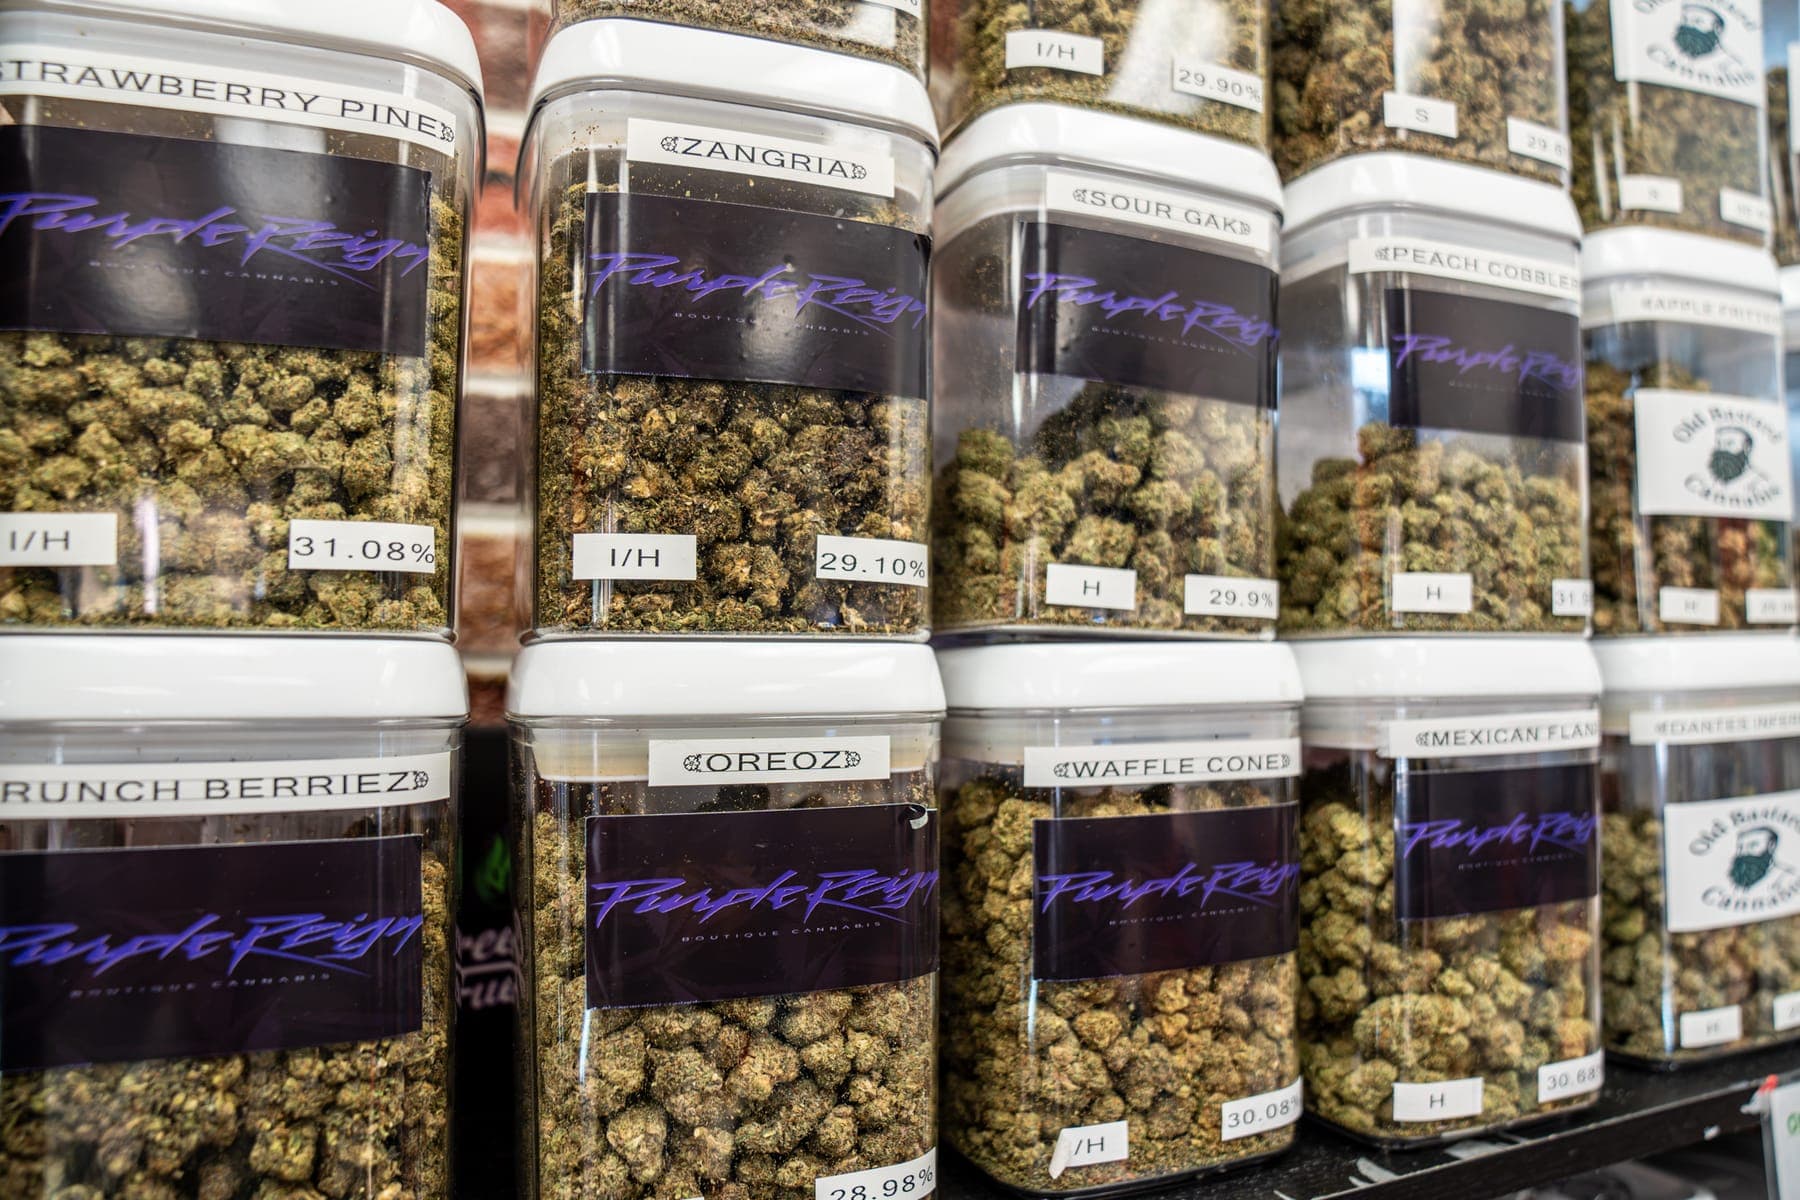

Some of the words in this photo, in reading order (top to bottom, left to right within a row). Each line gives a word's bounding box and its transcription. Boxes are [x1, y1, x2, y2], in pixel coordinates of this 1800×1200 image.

[1036, 42, 1076, 61] I/H
[0, 60, 322, 112] TRAWBERRY
[341, 99, 440, 138] PINE
[1179, 68, 1263, 104] 29.90%
[1415, 108, 1430, 123] S
[681, 136, 852, 180] ZANGRIA
[1091, 190, 1172, 220] SOUR
[1185, 209, 1239, 235] GAK
[0, 193, 249, 250] Purple
[240, 214, 428, 292] Reign
[1394, 247, 1480, 273] PEACH
[589, 251, 798, 303] Purple
[793, 273, 927, 337] Reign
[1024, 272, 1187, 320] Purple
[674, 311, 765, 326] BOUTIQU
[776, 322, 869, 337] NNABIS
[9, 530, 71, 552] I/H
[293, 535, 435, 564] 31.08%
[610, 548, 661, 568] I/H
[819, 552, 926, 579] 29.10%
[1083, 580, 1100, 596] H
[1209, 589, 1273, 609] 29.9%
[1426, 586, 1441, 600] H
[1432, 727, 1539, 747] MEXICAN
[706, 751, 842, 772] OREOZ
[1074, 757, 1194, 778] WAFFLE
[1207, 753, 1280, 773] CONE
[2, 779, 181, 803] RUNCH
[205, 771, 411, 799] BERRIEZ
[1402, 812, 1533, 860] Purple
[591, 869, 808, 929] Purple
[802, 868, 939, 924] Reign
[1038, 861, 1205, 914] Purple
[0, 914, 236, 978] Purple
[225, 912, 423, 977] Reign
[681, 930, 779, 943] BOUTIQUE
[791, 921, 881, 935] CANNABIS
[1429, 1093, 1445, 1109] H
[830, 1165, 933, 1200] 28.98%
